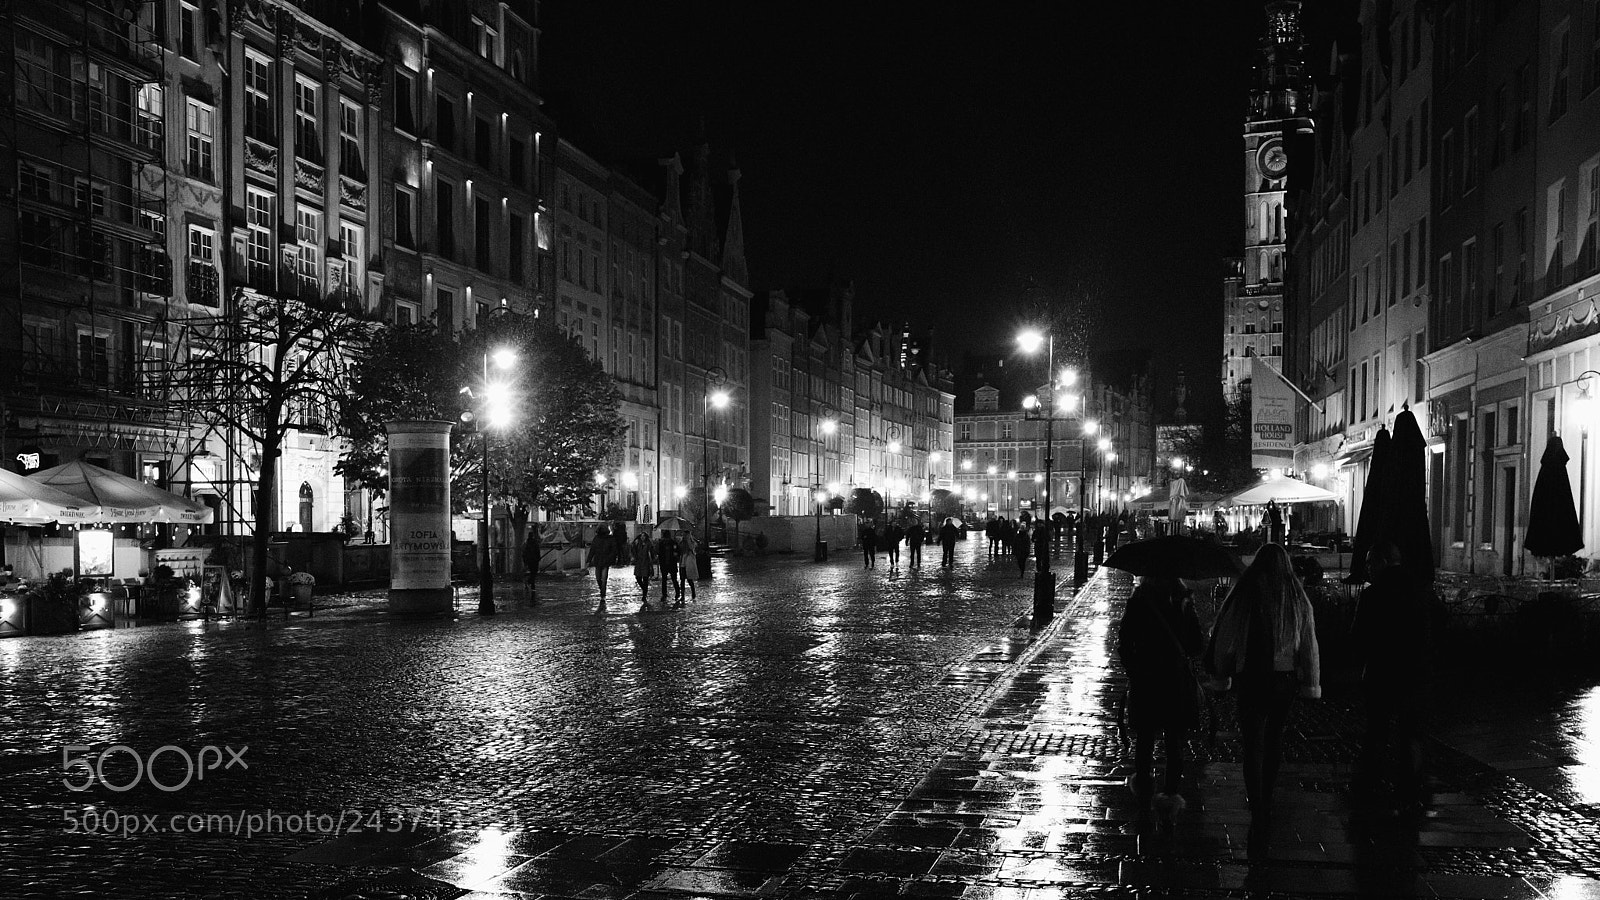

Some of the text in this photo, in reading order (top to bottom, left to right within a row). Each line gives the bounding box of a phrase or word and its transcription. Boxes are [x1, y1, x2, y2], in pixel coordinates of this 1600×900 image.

[1255, 424, 1291, 433] HOLLAND
[1261, 431, 1285, 439] HOUSE
[1253, 441, 1292, 449] RESIDENCE
[410, 530, 438, 539] ZOFIA
